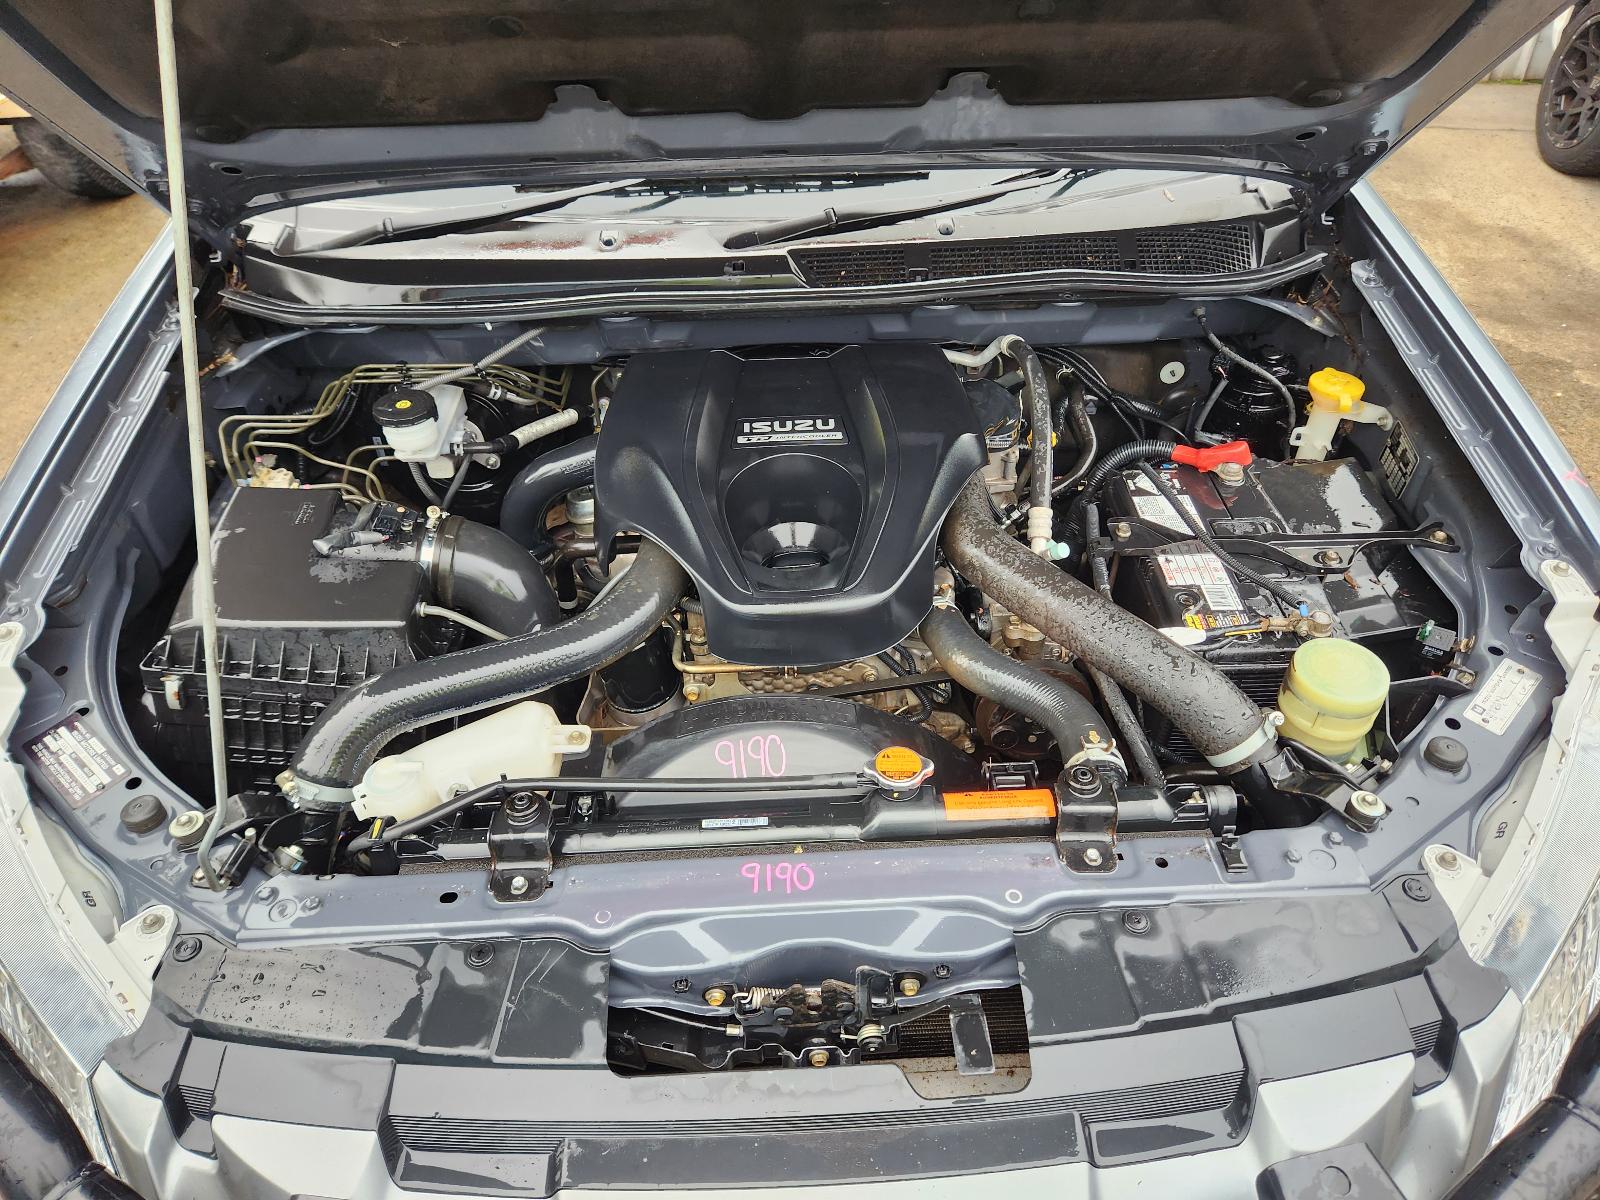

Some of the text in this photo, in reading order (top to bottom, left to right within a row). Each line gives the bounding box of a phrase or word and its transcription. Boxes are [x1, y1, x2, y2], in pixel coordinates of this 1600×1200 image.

[743, 418, 835, 433] ISUZU
[714, 734, 786, 779] 9190
[741, 862, 815, 894] 9190
